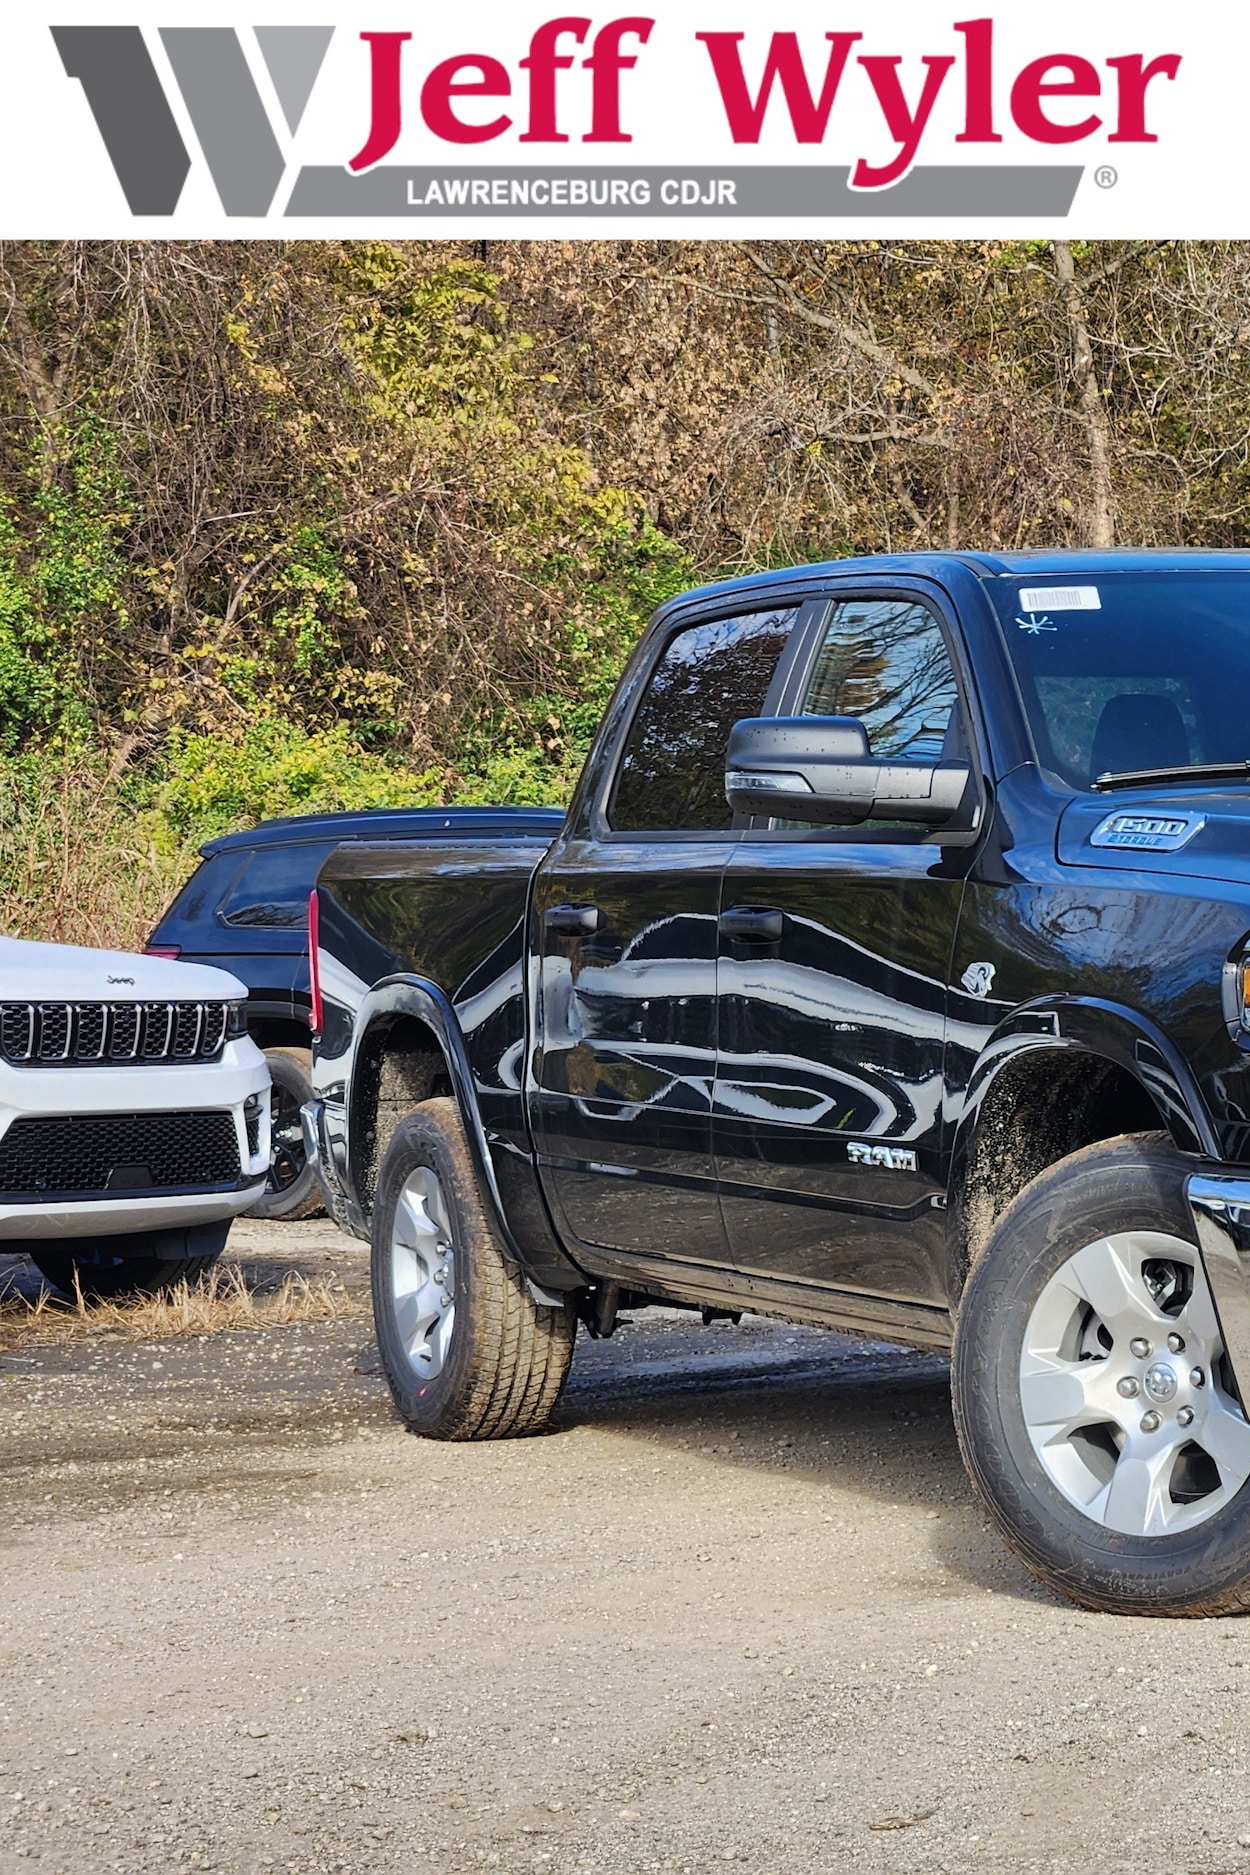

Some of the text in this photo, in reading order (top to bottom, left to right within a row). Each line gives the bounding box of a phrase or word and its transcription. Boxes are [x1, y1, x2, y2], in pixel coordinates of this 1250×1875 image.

[1112, 816, 1188, 836] 1500
[107, 975, 135, 987] Jeep
[846, 1141, 918, 1172] RAM
